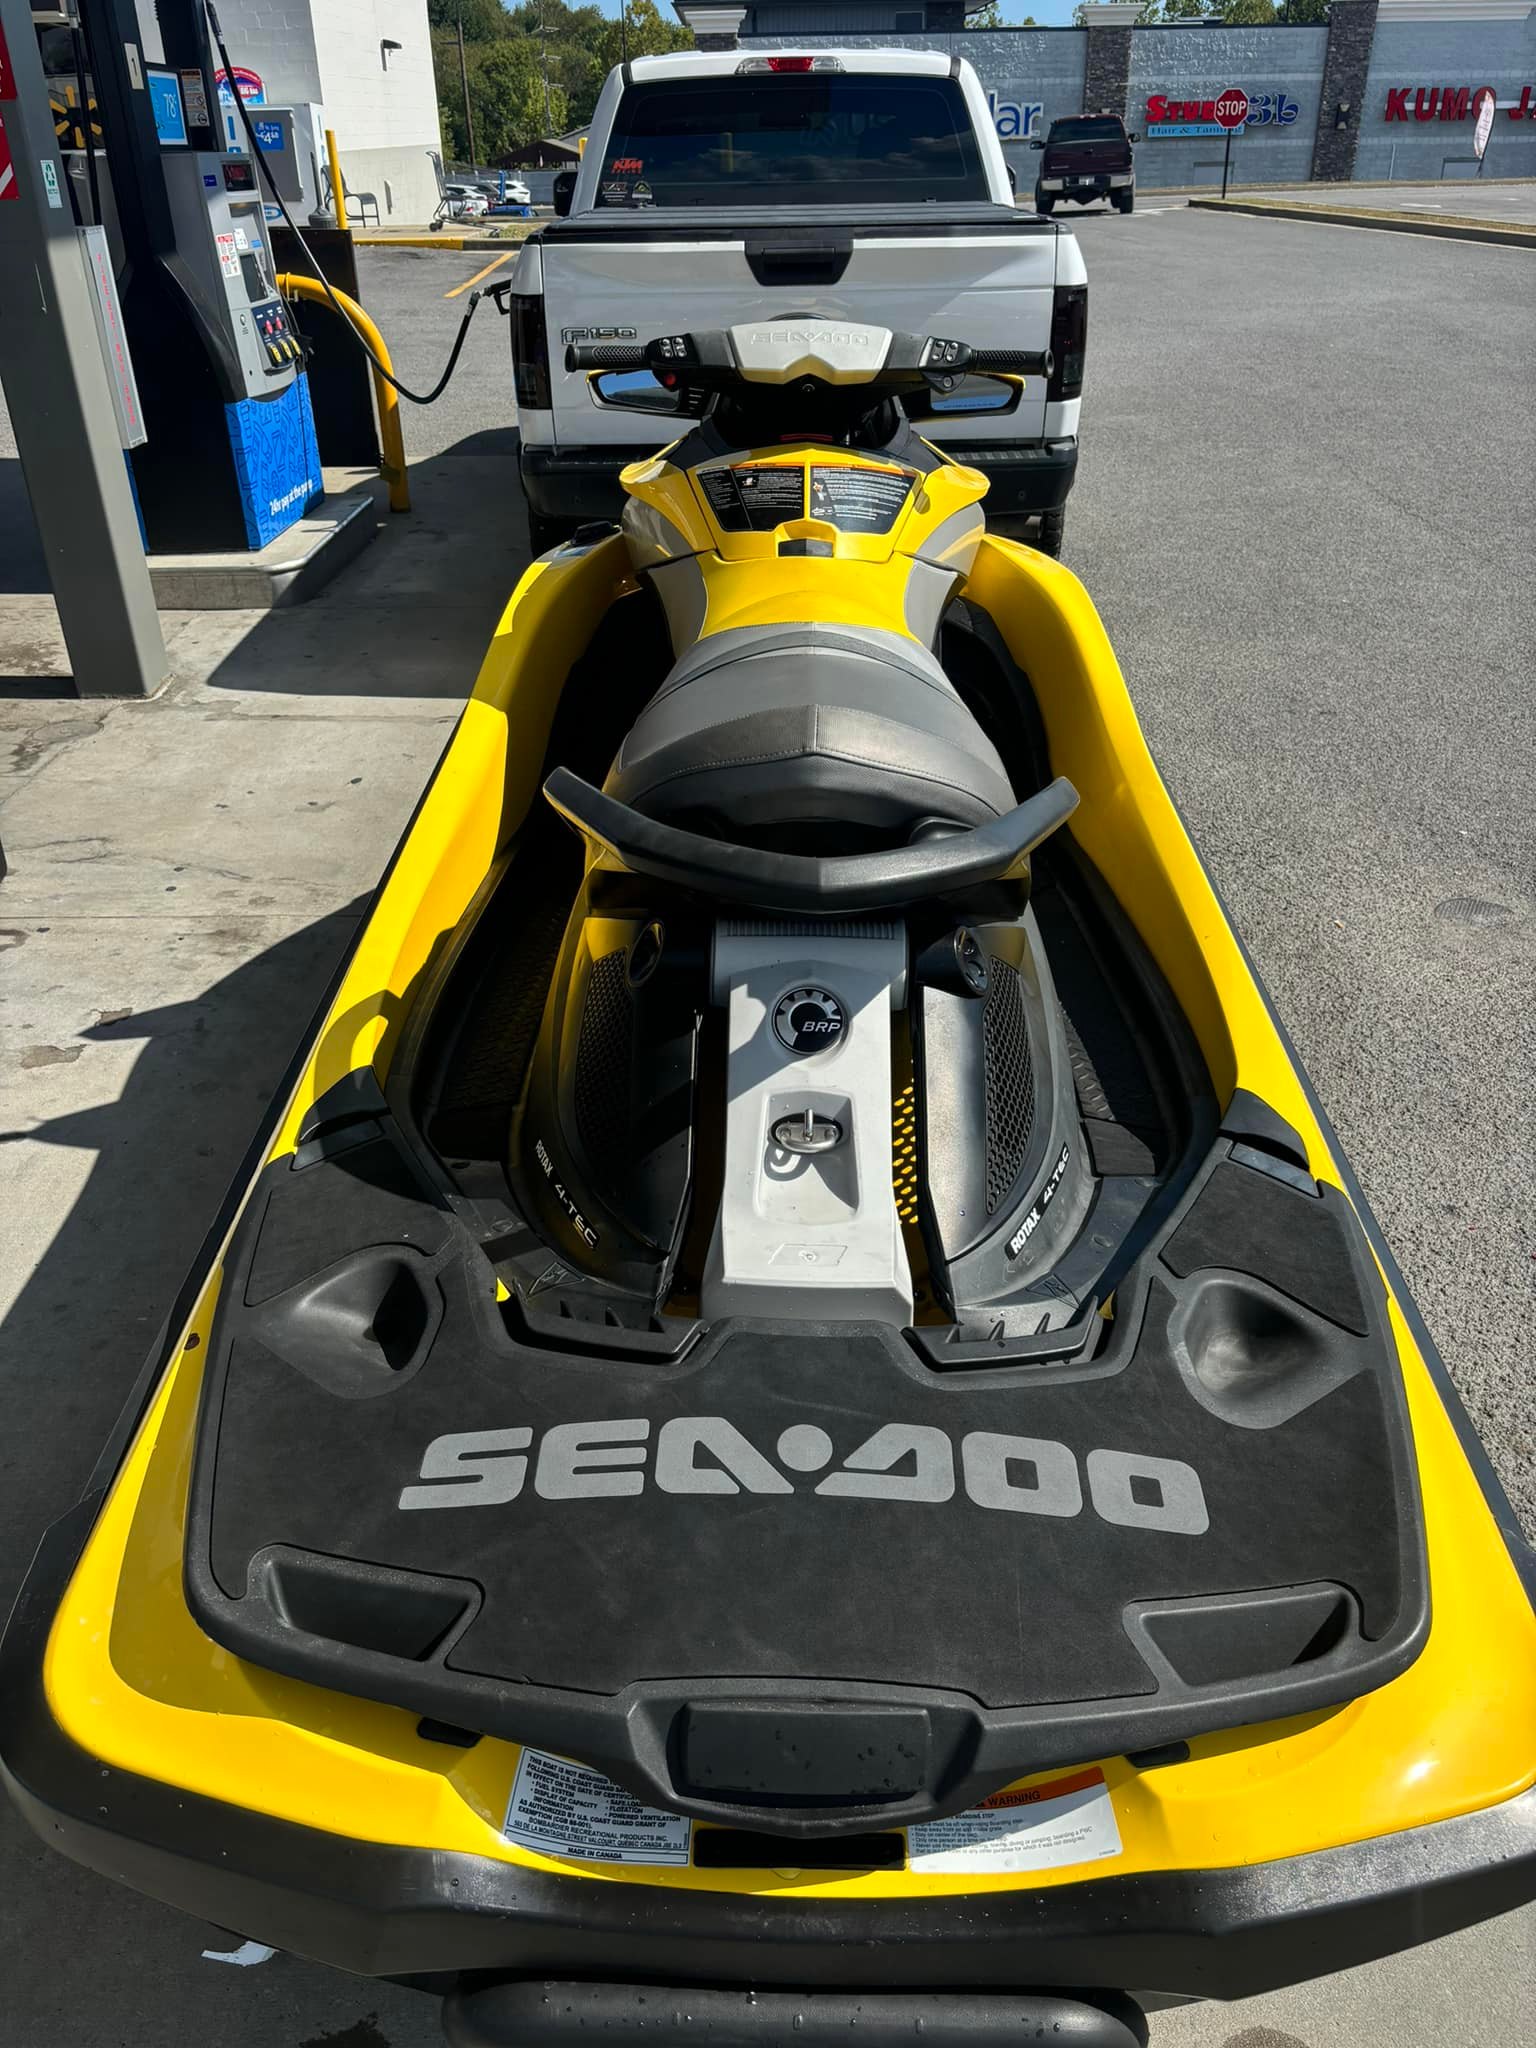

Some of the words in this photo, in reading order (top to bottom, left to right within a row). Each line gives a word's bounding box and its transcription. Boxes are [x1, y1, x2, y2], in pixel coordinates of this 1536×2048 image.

[1216, 100, 1247, 117] STOP
[1384, 86, 1497, 122] KUMO
[1151, 126, 1178, 135] Hair
[1179, 126, 1189, 135] &
[612, 157, 644, 169] KTM
[801, 1020, 841, 1033] BRP
[536, 1139, 553, 1177] ROTAX
[555, 1184, 597, 1248] 4-TEC
[1010, 1207, 1040, 1254] ROTAX
[1043, 1146, 1070, 1203] 4-TEC
[528, 1763, 560, 1780] FOLLOWING
[560, 1774, 571, 1783] U.S.
[572, 1777, 592, 1788] COAST
[593, 1782, 614, 1792] GUARD
[530, 1756, 541, 1766] THIS
[542, 1760, 558, 1771] BOAT
[564, 1768, 577, 1777] NOT
[578, 1771, 609, 1784] REQUIRED
[533, 1772, 554, 1785] EFFECT
[554, 1779, 564, 1788] ON
[564, 1782, 576, 1791] THE
[578, 1786, 592, 1796] DATE
[594, 1789, 602, 1797] OF
[536, 1780, 550, 1790] FUEL
[551, 1784, 574, 1798] SYSTEM
[533, 1796, 574, 1812] INFORMATION
[534, 1788, 559, 1801] DISPLAY
[568, 1798, 598, 1809] CAPACITY
[988, 1790, 1040, 1806] WARNING
[518, 1806, 552, 1820] EXEMPTION
[528, 1800, 566, 1817] AUTHORIZED
[567, 1810, 576, 1818] BY
[590, 1816, 610, 1825] COAST
[612, 1818, 634, 1826] GUARD
[608, 1812, 640, 1820] POWERED
[528, 1816, 570, 1832] BOMBARDIER
[570, 1826, 618, 1839] RECREATIONAL
[620, 1833, 654, 1842] PRODUCTS
[538, 1826, 566, 1838] MONTAGNE
[567, 1833, 588, 1842] STREET
[914, 1826, 928, 1834] Keep
[928, 1826, 942, 1834] away
[1052, 1831, 1074, 1840] boarding
[568, 1847, 586, 1856] MADE
[596, 1851, 622, 1859] CANADA
[1023, 1842, 1038, 1850] which
